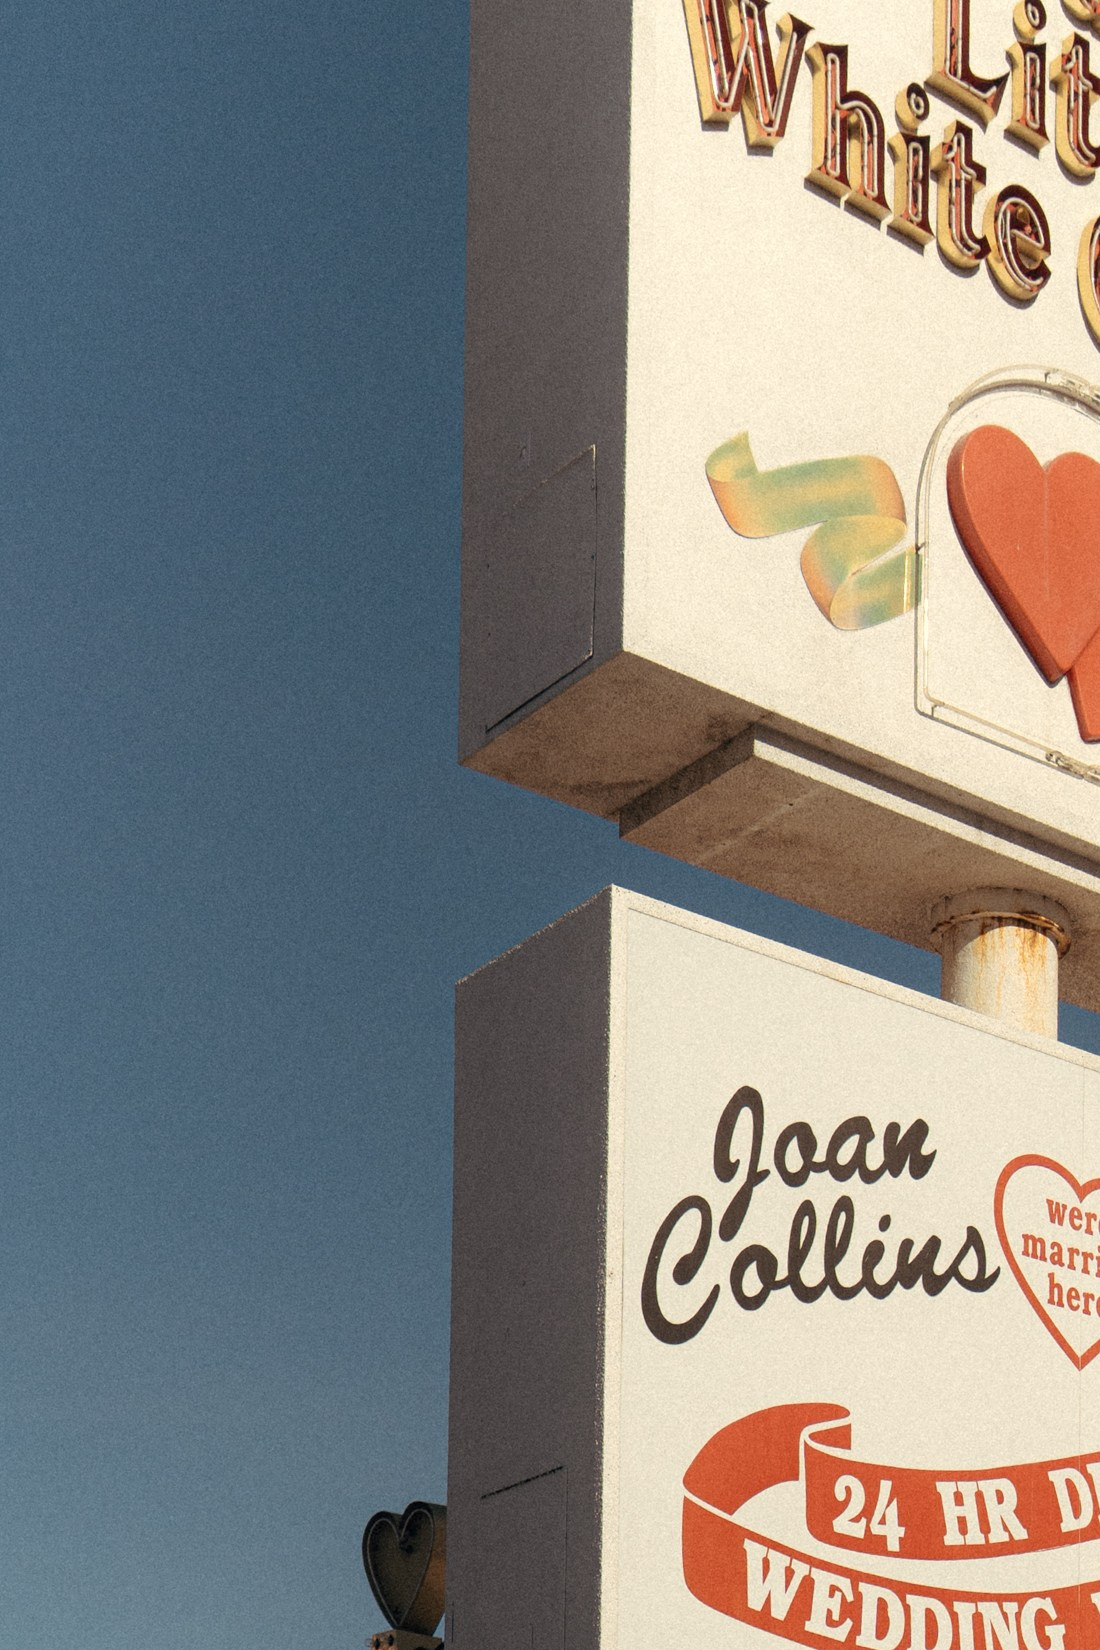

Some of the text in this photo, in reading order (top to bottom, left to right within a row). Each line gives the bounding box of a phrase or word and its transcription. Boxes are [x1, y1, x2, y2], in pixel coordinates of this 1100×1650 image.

[683, 0, 1051, 301] White
[713, 1086, 937, 1242] Joan
[640, 1194, 1000, 1345] Collins
[832, 1475, 905, 1552] 24
[937, 1478, 1029, 1546] HR
